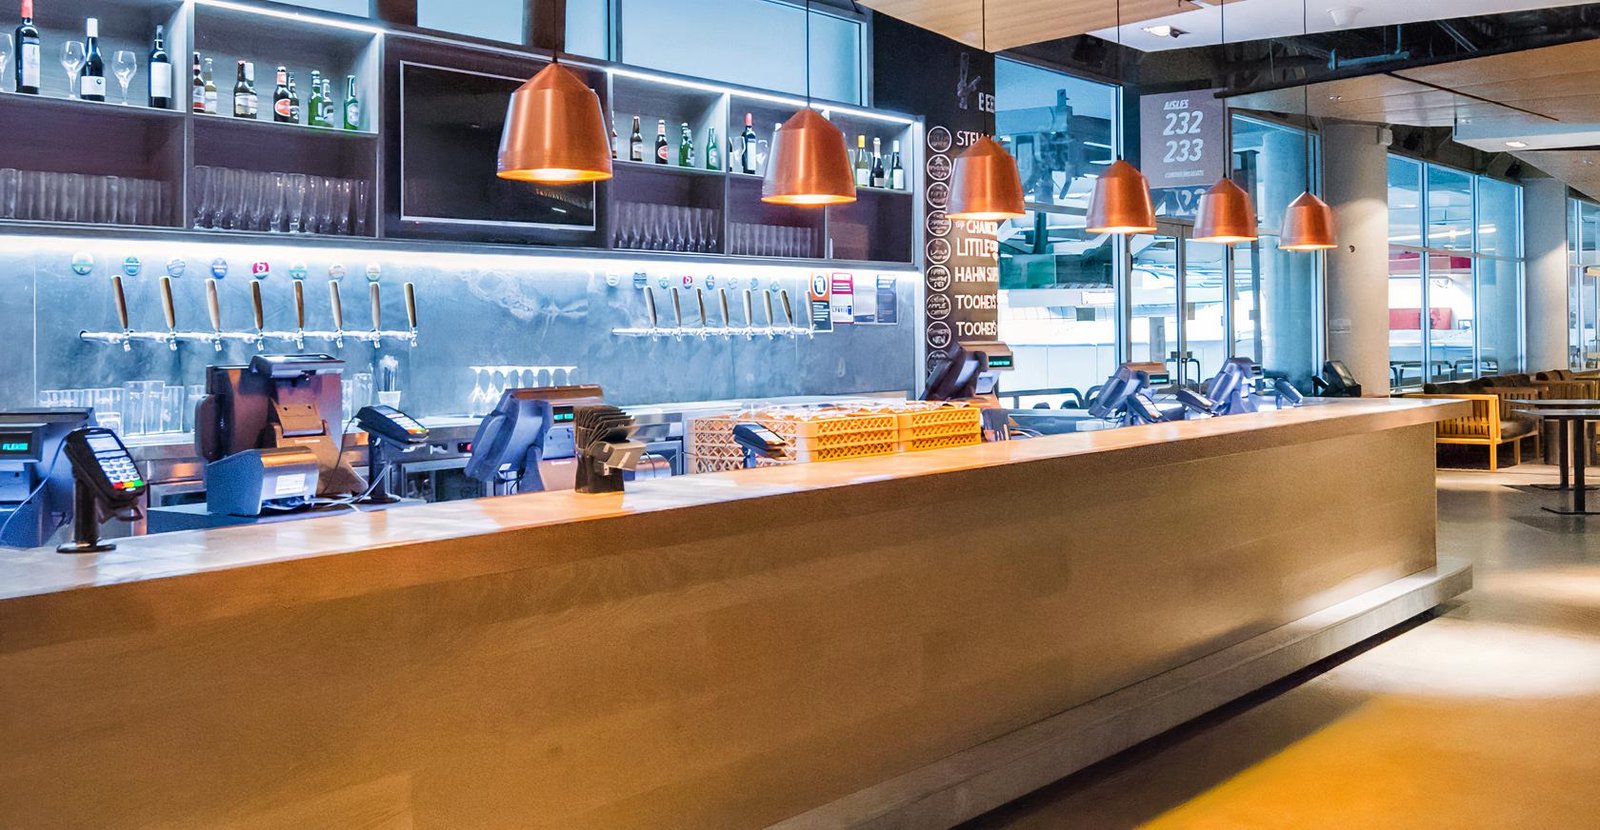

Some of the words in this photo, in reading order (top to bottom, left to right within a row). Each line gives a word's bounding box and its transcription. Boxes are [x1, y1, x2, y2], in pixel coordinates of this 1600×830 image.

[1164, 99, 1189, 110] AISLES
[1163, 110, 1204, 136] 232
[1163, 138, 1204, 163] 233
[954, 266, 986, 282] HAHN
